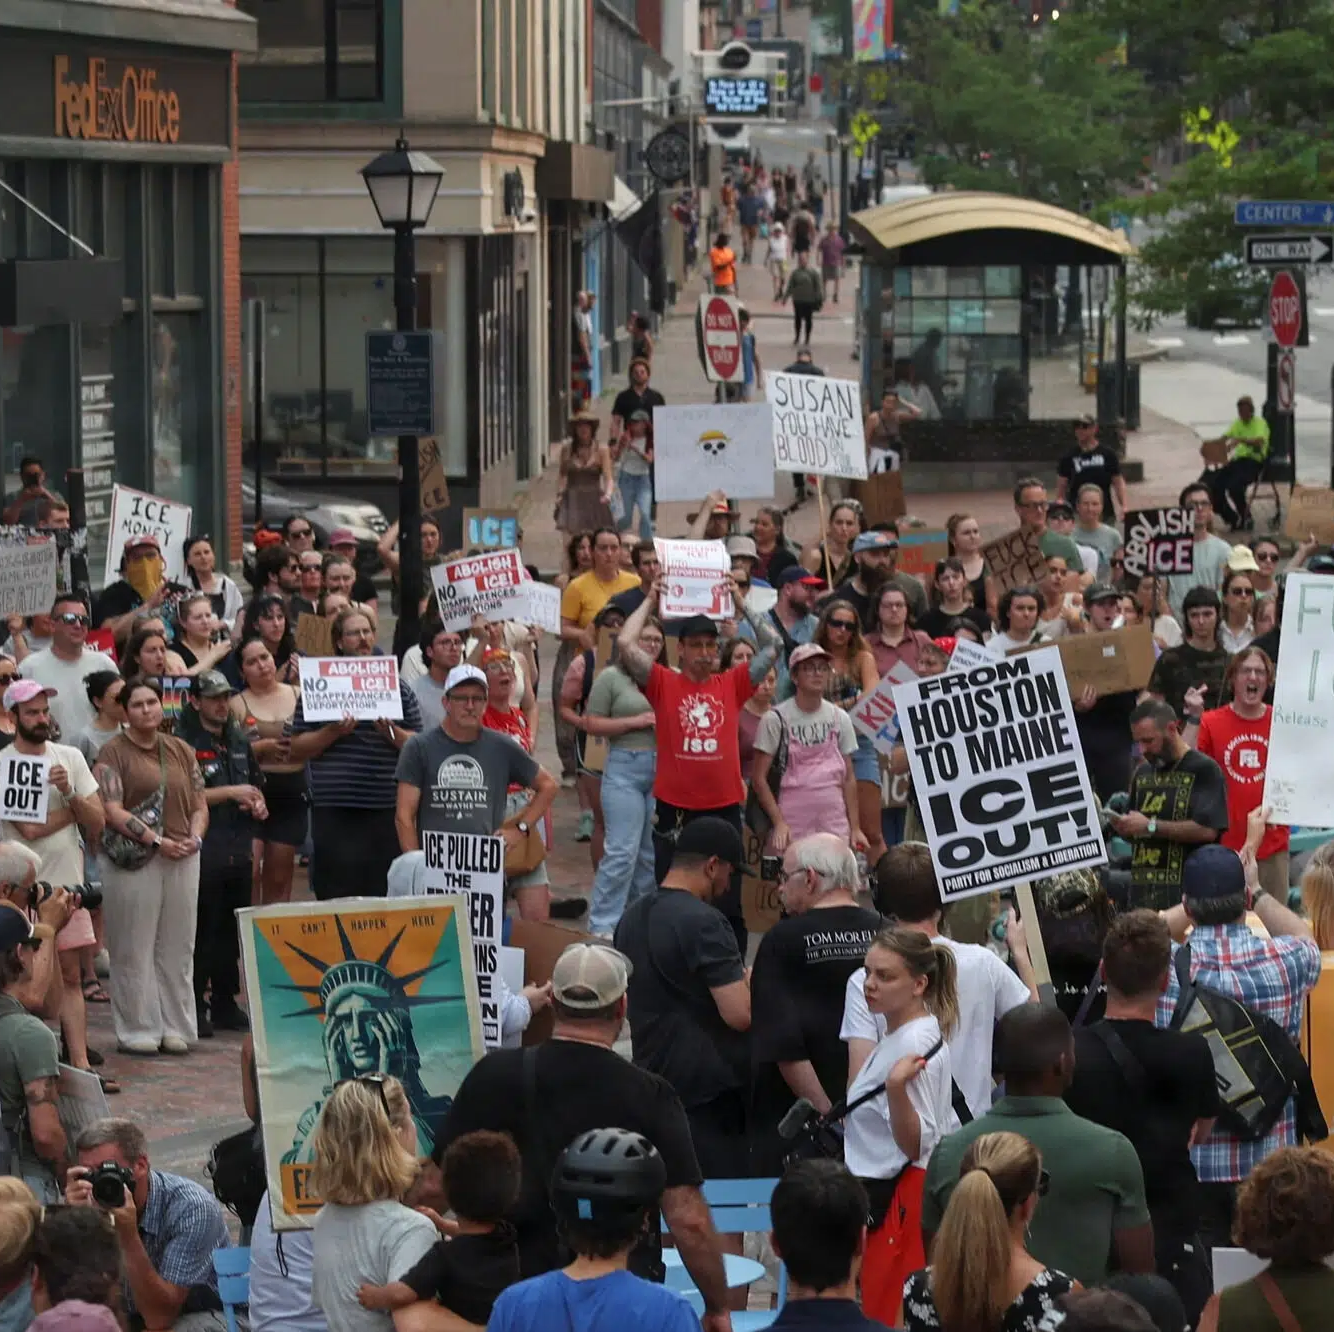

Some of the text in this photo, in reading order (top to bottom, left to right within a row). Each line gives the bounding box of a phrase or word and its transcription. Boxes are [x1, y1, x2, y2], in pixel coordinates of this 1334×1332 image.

[54, 54, 180, 144] FedEx Office
[1244, 205, 1302, 220] CENTER
[1254, 242, 1281, 257] ONE
[706, 313, 717, 326] DO
[1271, 298, 1298, 323] STOP
[775, 377, 853, 419] SUSAN
[775, 411, 808, 436] YOU
[813, 416, 851, 438] HAVE
[776, 434, 828, 468] BLOOD
[131, 497, 171, 524] ICE
[470, 516, 517, 547] ICE
[1123, 508, 1195, 577] ABOLISH
[984, 530, 1040, 572] FUCK
[1147, 539, 1193, 573] ICE
[454, 556, 512, 579] ABOLISH
[484, 571, 515, 588] ICE!
[1000, 557, 1047, 588] ICE
[438, 584, 456, 601] NO
[327, 662, 390, 675] ABOLISH
[918, 657, 1030, 700] FROM
[303, 677, 328, 691] NO
[360, 677, 391, 690] ICE!
[306, 701, 377, 710] DEPORTATIONS
[907, 671, 1062, 745] HOUSTON
[1273, 704, 1329, 729] Release
[915, 741, 959, 787] TO
[964, 712, 1074, 775] MAINE
[9, 760, 44, 786] ICE
[4, 787, 43, 811] OUT
[431, 790, 488, 802] SUSTAIN
[445, 802, 475, 811] WAYNE
[928, 760, 1084, 836] ICE
[1141, 790, 1166, 813] Let
[938, 807, 1091, 869] OUT!
[424, 831, 501, 874] ICE PULLED
[945, 842, 1099, 893] PARTY FOR SOCIALISM LIBERATION
[444, 872, 471, 889] THE
[271, 914, 436, 935] IT CAN'T HAPPEN HERE
[804, 932, 832, 947] TOM
[806, 950, 819, 959] THE
